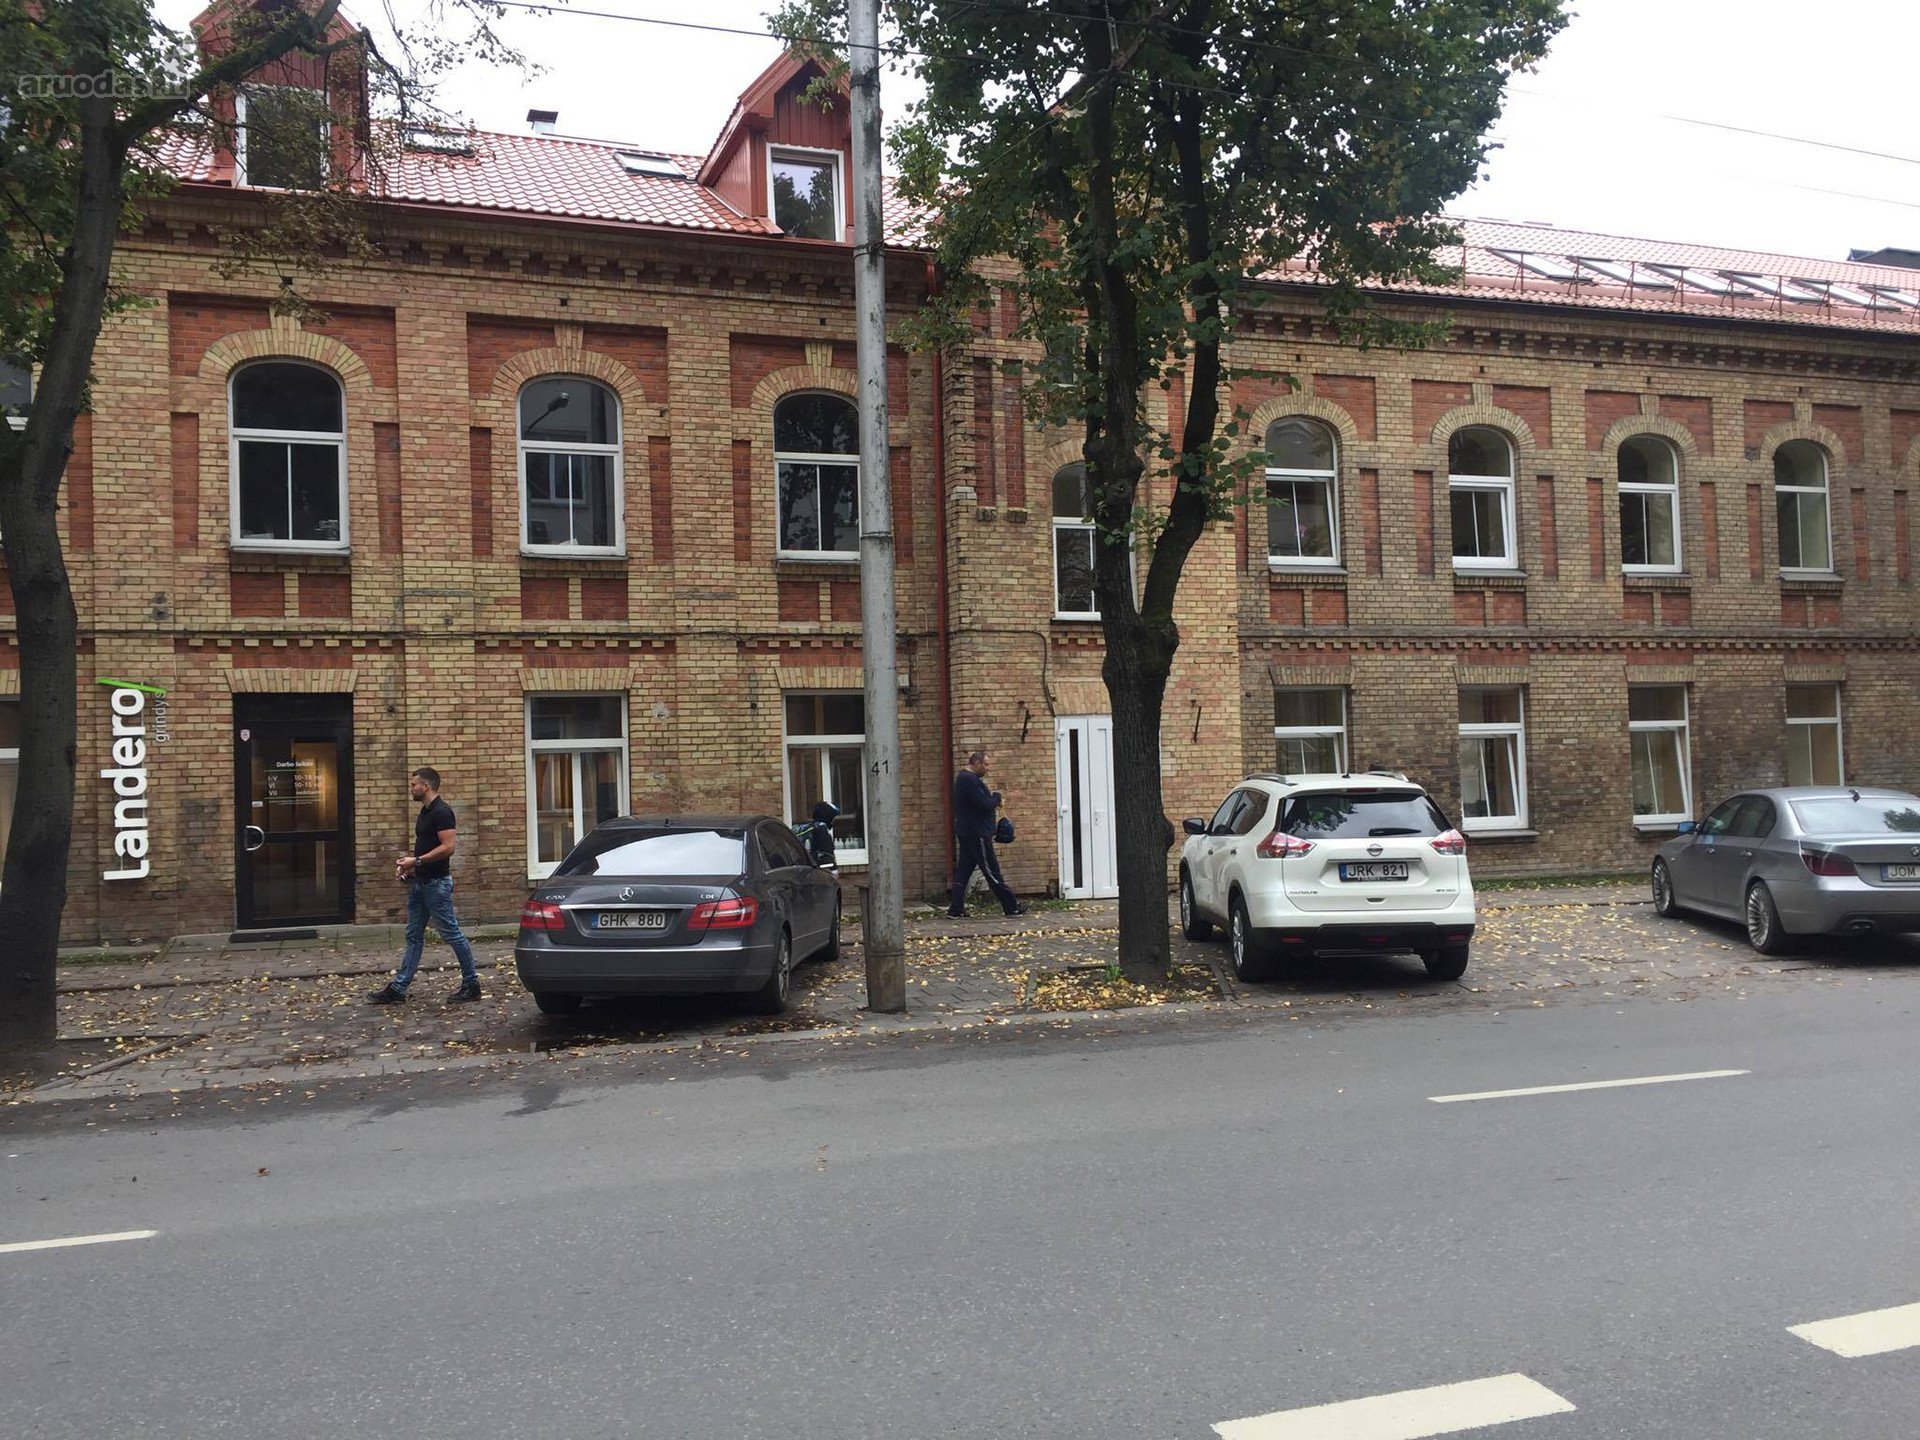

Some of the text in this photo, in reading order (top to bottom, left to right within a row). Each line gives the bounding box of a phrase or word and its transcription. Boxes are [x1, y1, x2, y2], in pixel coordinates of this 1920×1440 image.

[871, 759, 888, 776] 41
[100, 688, 150, 880] Landero
[1348, 865, 1405, 876] JRK 821
[1890, 866, 1916, 877] JOM
[600, 914, 663, 926] GHK 880
